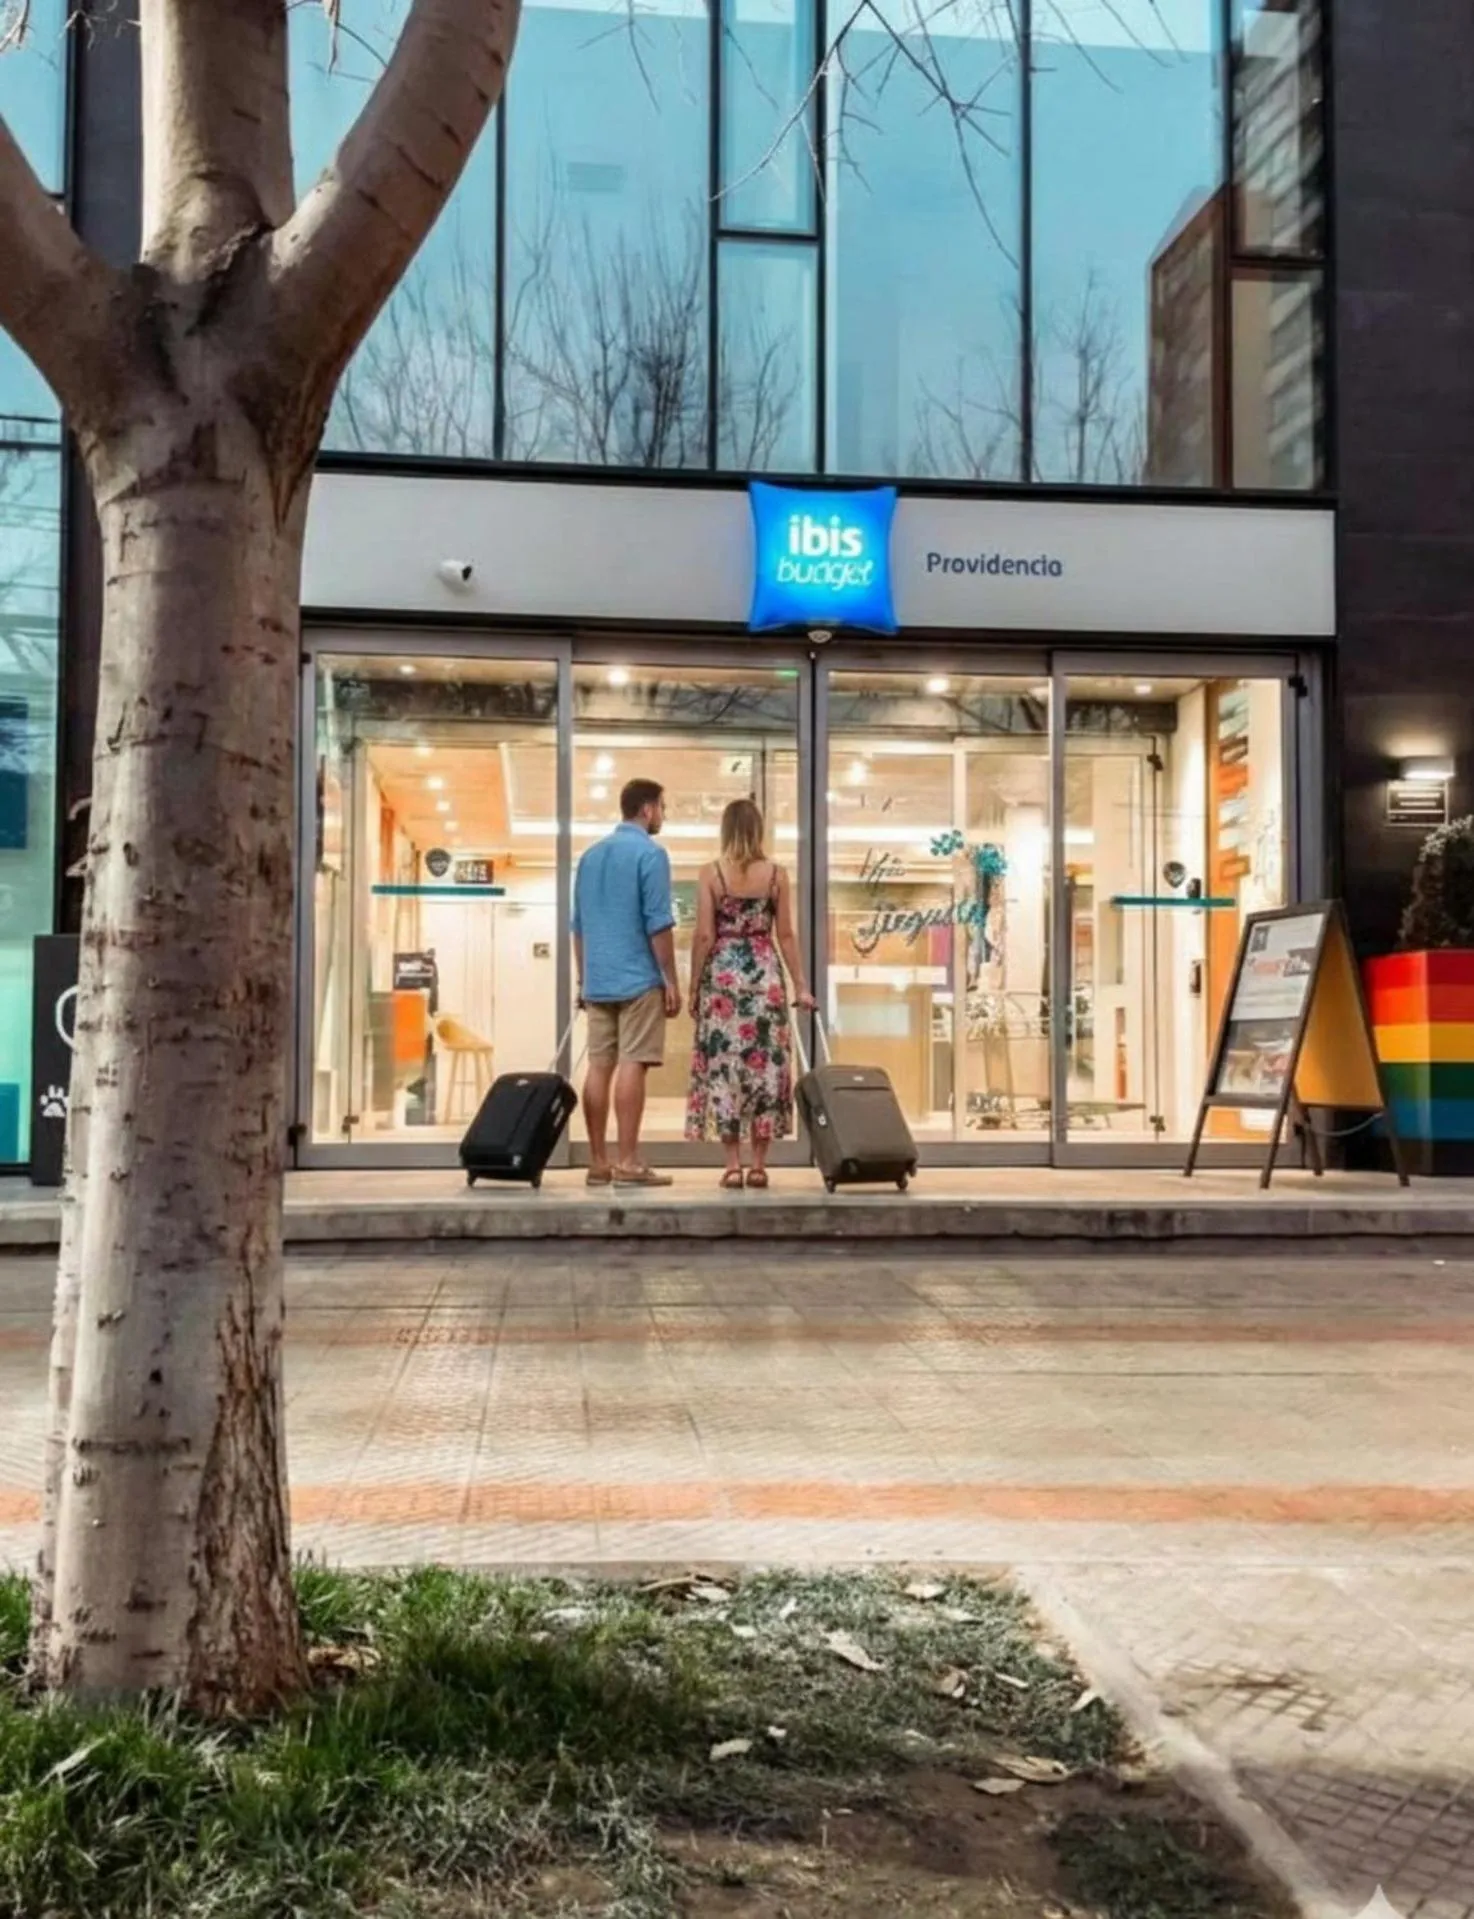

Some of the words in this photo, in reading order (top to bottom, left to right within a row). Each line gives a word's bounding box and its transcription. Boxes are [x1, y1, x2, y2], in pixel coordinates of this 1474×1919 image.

[789, 514, 863, 557] ibis
[777, 556, 874, 591] budget
[926, 552, 1063, 577] Providencia
